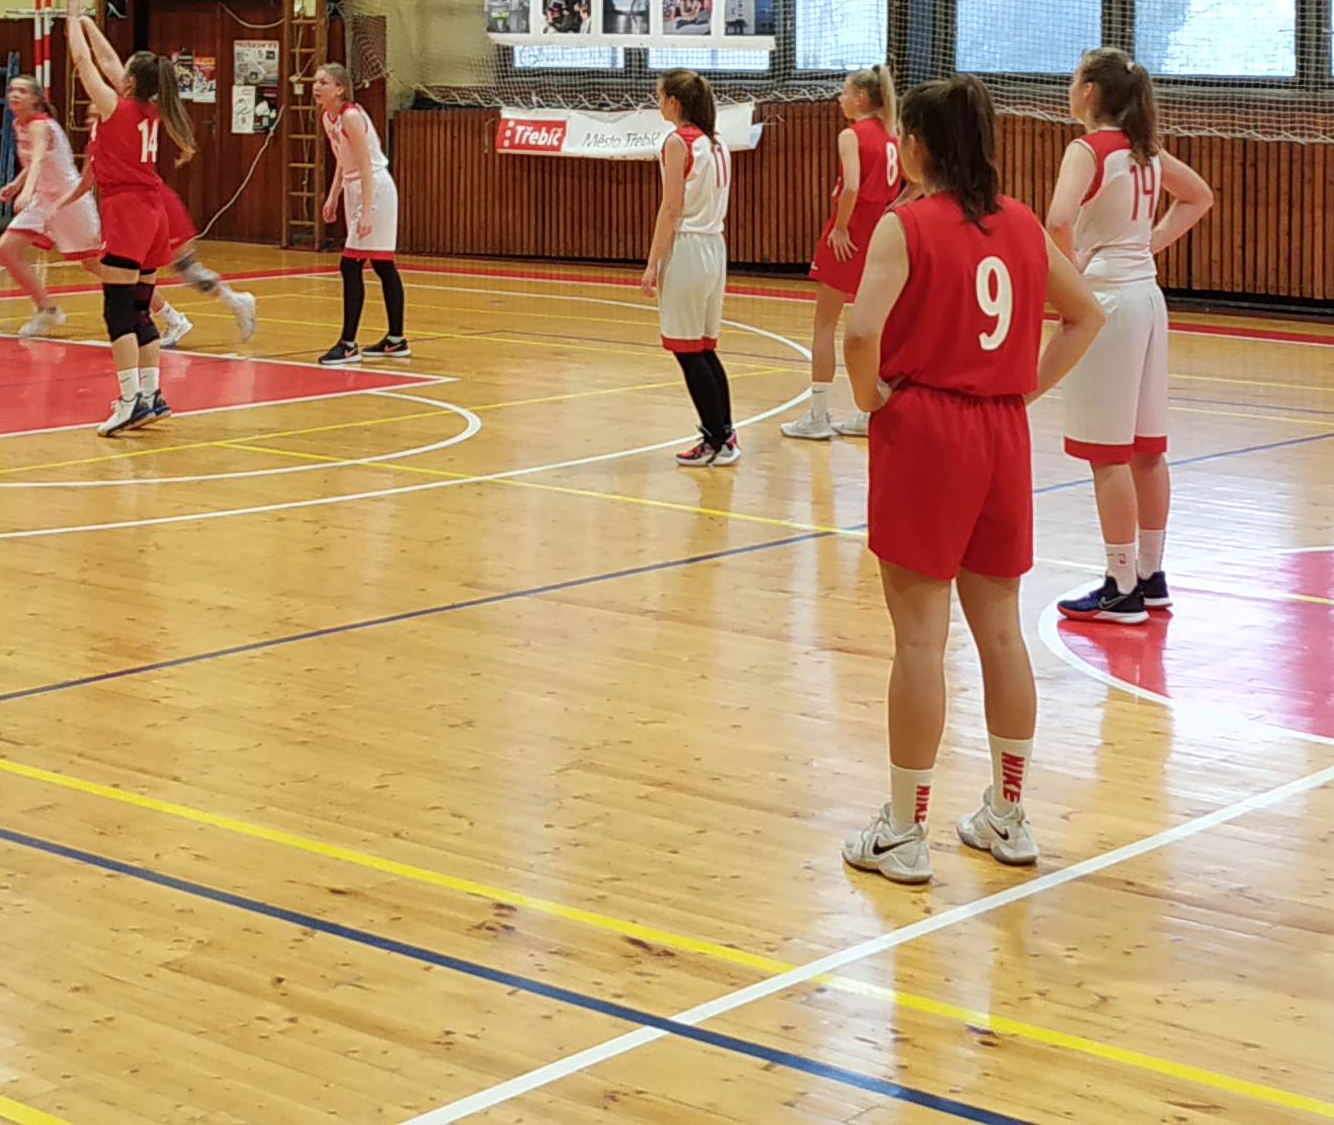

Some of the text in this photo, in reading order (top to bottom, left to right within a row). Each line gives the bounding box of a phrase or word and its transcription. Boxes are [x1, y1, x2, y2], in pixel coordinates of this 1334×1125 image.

[137, 118, 159, 163] 14
[514, 125, 564, 146] Třebíč
[581, 132, 621, 147] Město
[713, 145, 728, 188] 11
[885, 141, 899, 187] 8
[1130, 162, 1156, 221] 14
[975, 255, 1013, 351] 9
[1000, 751, 1026, 804] NIKE
[914, 784, 932, 825] NIKE
